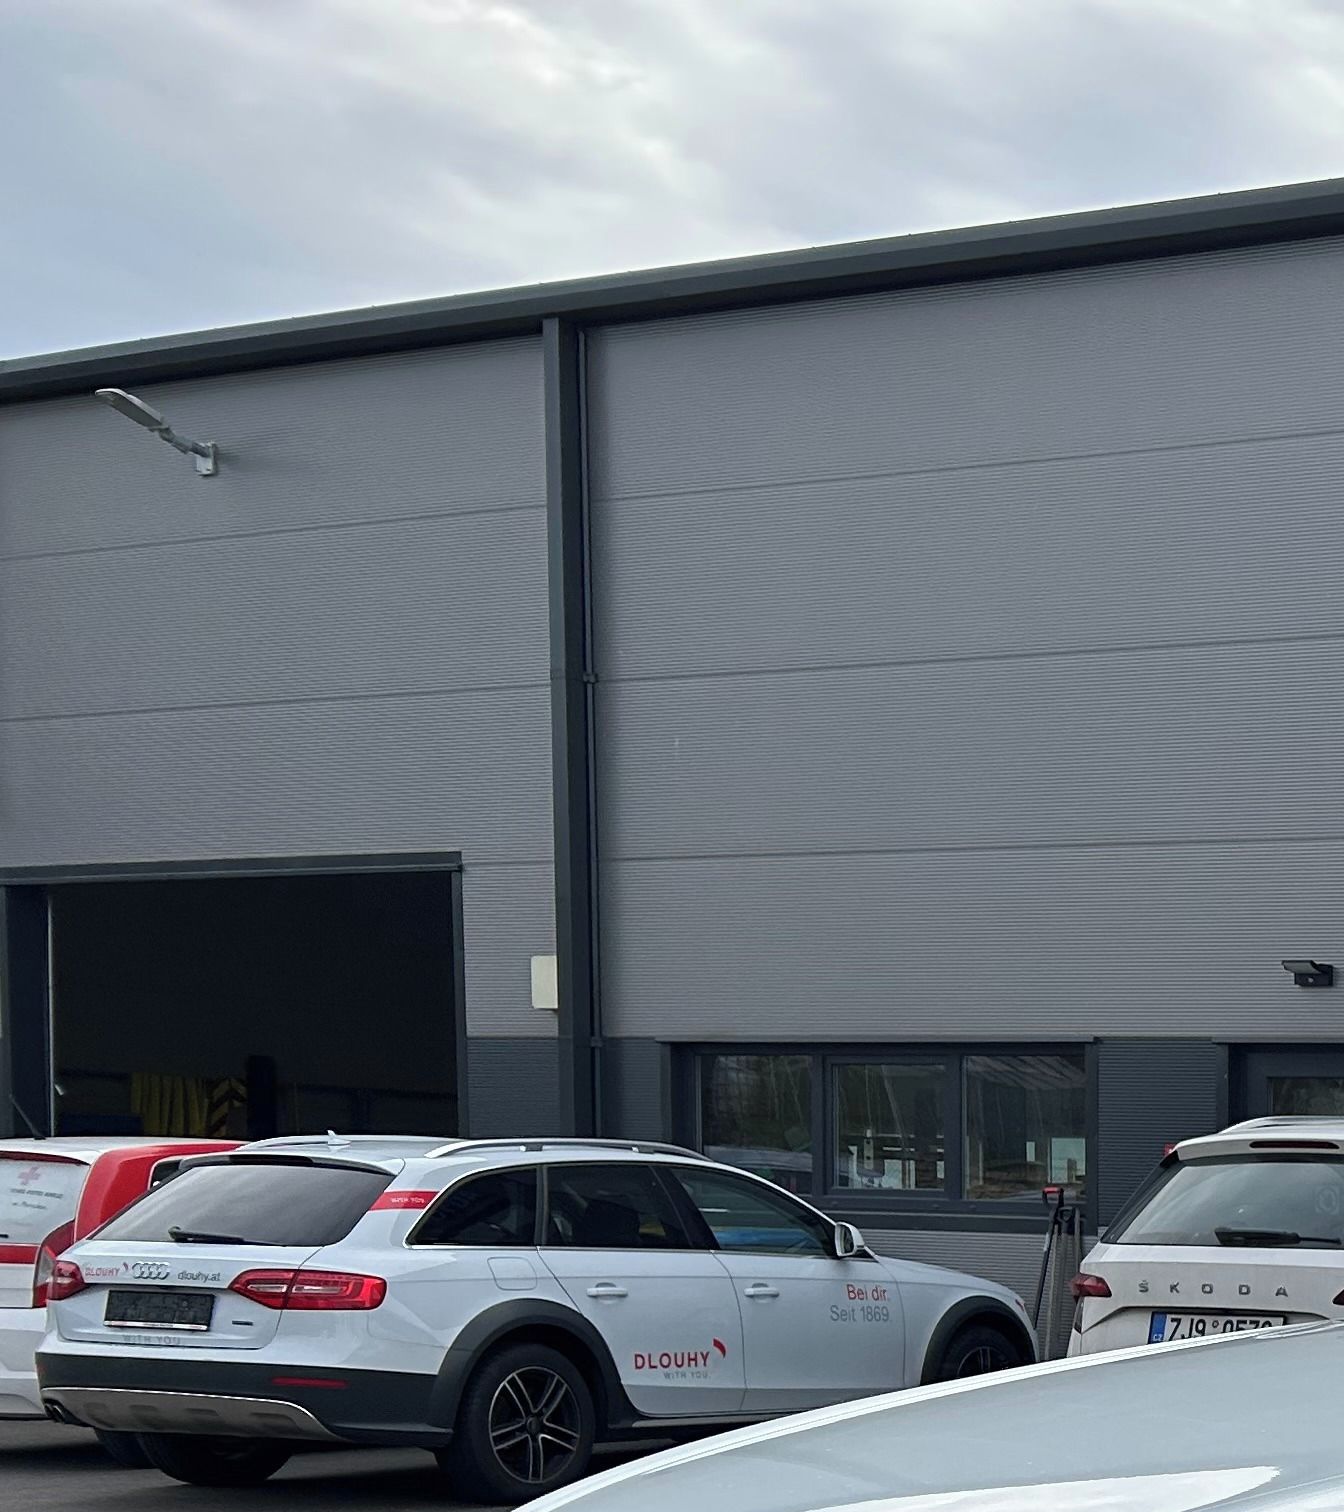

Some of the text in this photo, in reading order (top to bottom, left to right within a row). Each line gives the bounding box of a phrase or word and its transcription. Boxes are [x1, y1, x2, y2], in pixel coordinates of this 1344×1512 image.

[177, 1270, 221, 1283] dlouhy.at
[846, 1284, 868, 1301] Bei
[830, 1305, 856, 1322] Seit
[634, 1351, 710, 1369] DLOUHY
